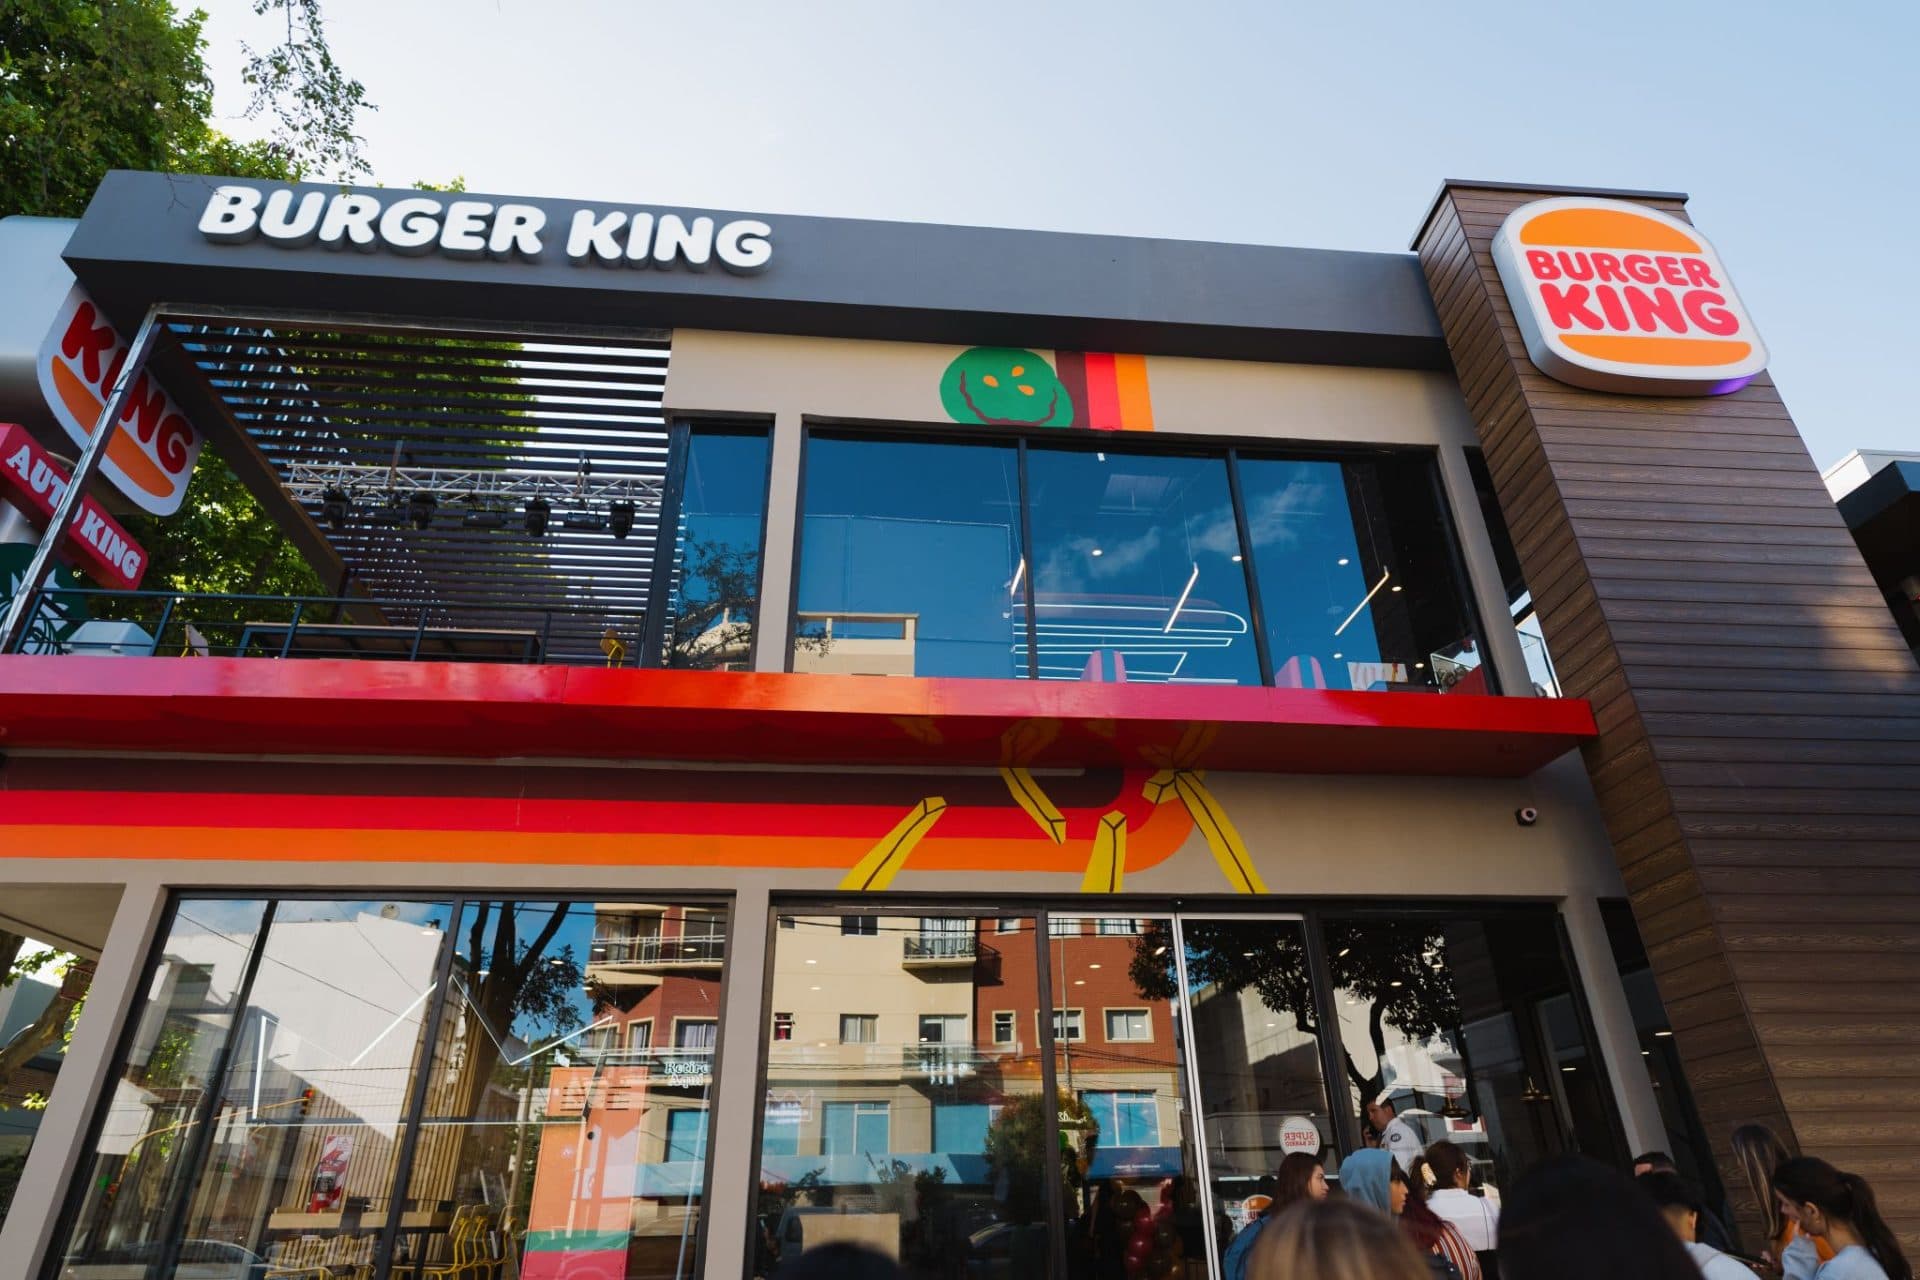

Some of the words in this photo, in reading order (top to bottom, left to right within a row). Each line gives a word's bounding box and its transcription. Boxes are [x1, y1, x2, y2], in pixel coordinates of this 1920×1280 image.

[198, 185, 547, 256] BURGER
[565, 209, 773, 270] KING
[1525, 249, 1721, 289] BURGER
[1538, 282, 1740, 337] KING
[5, 444, 84, 524] AUT
[80, 508, 142, 580] KING
